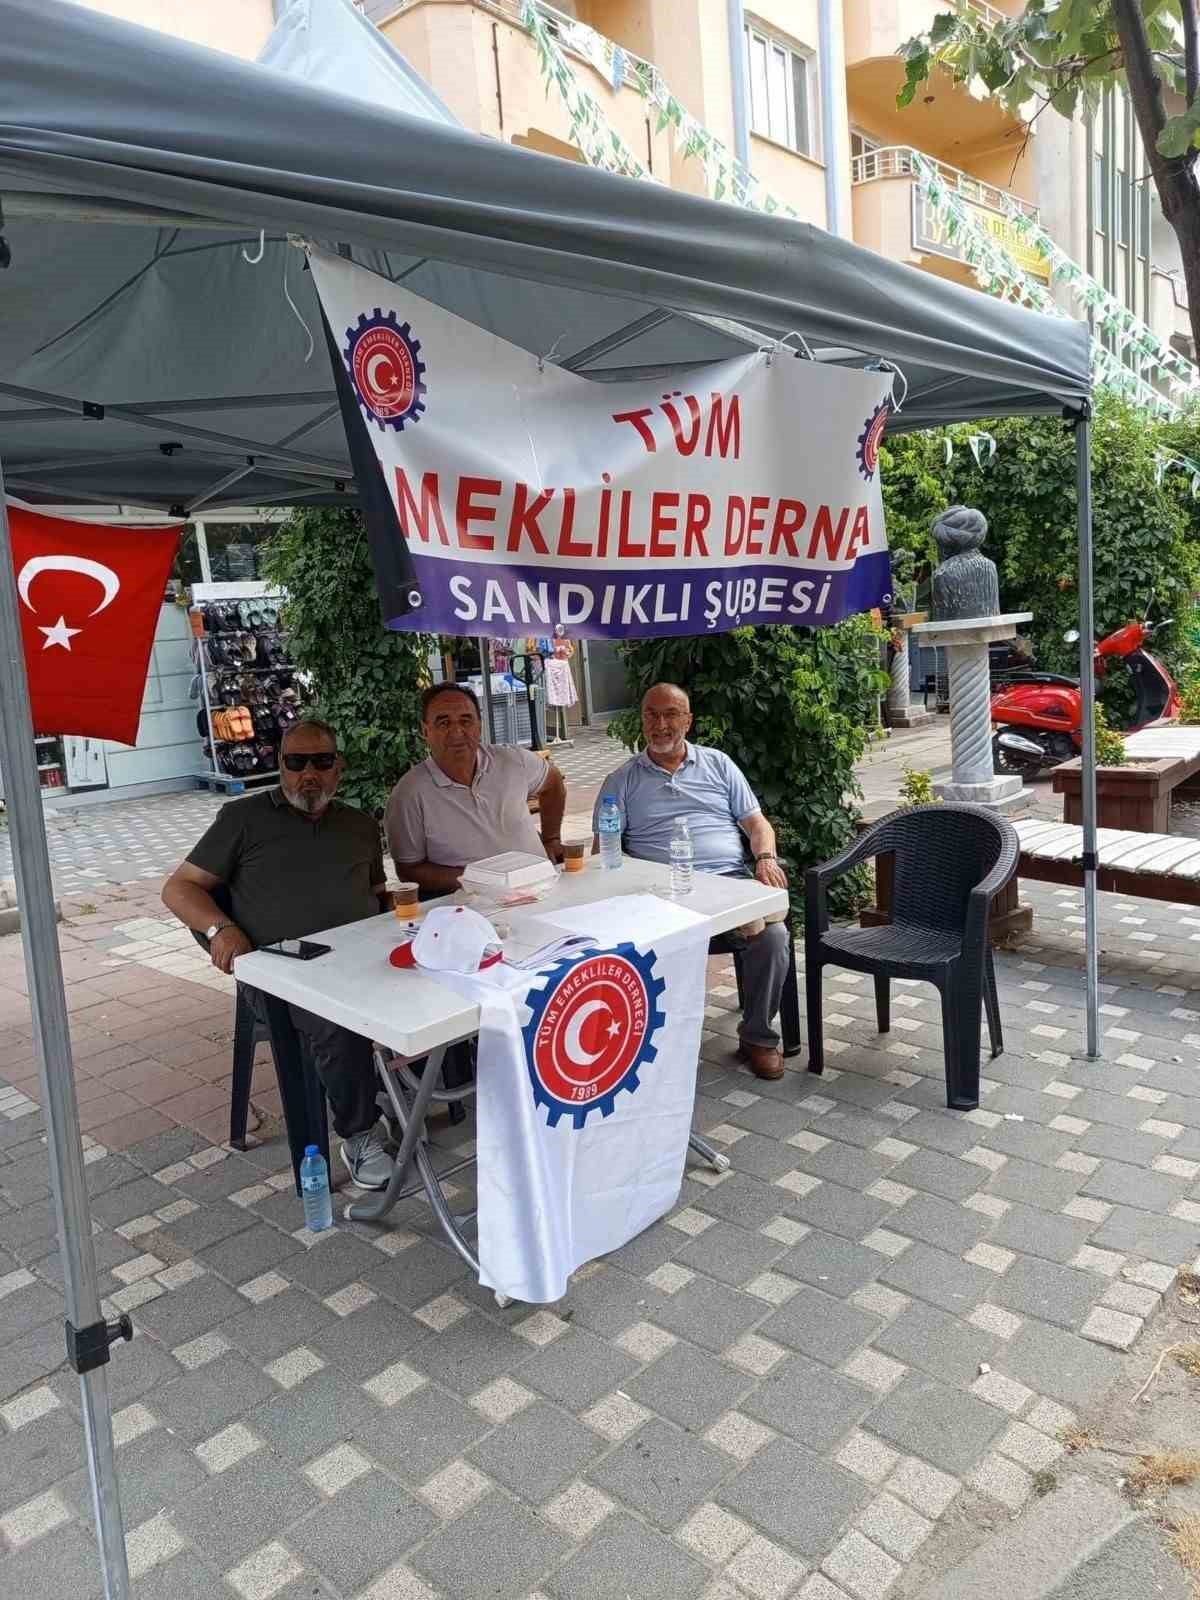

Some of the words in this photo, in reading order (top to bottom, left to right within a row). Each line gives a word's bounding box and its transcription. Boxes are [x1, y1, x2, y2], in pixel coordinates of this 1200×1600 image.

[612, 389, 740, 460] TÜM
[394, 466, 712, 558] MEKLİLER
[449, 574, 692, 626] SANDIKLI
[705, 574, 833, 629] ŞUBESİ
[538, 1009, 559, 1048] TÜM
